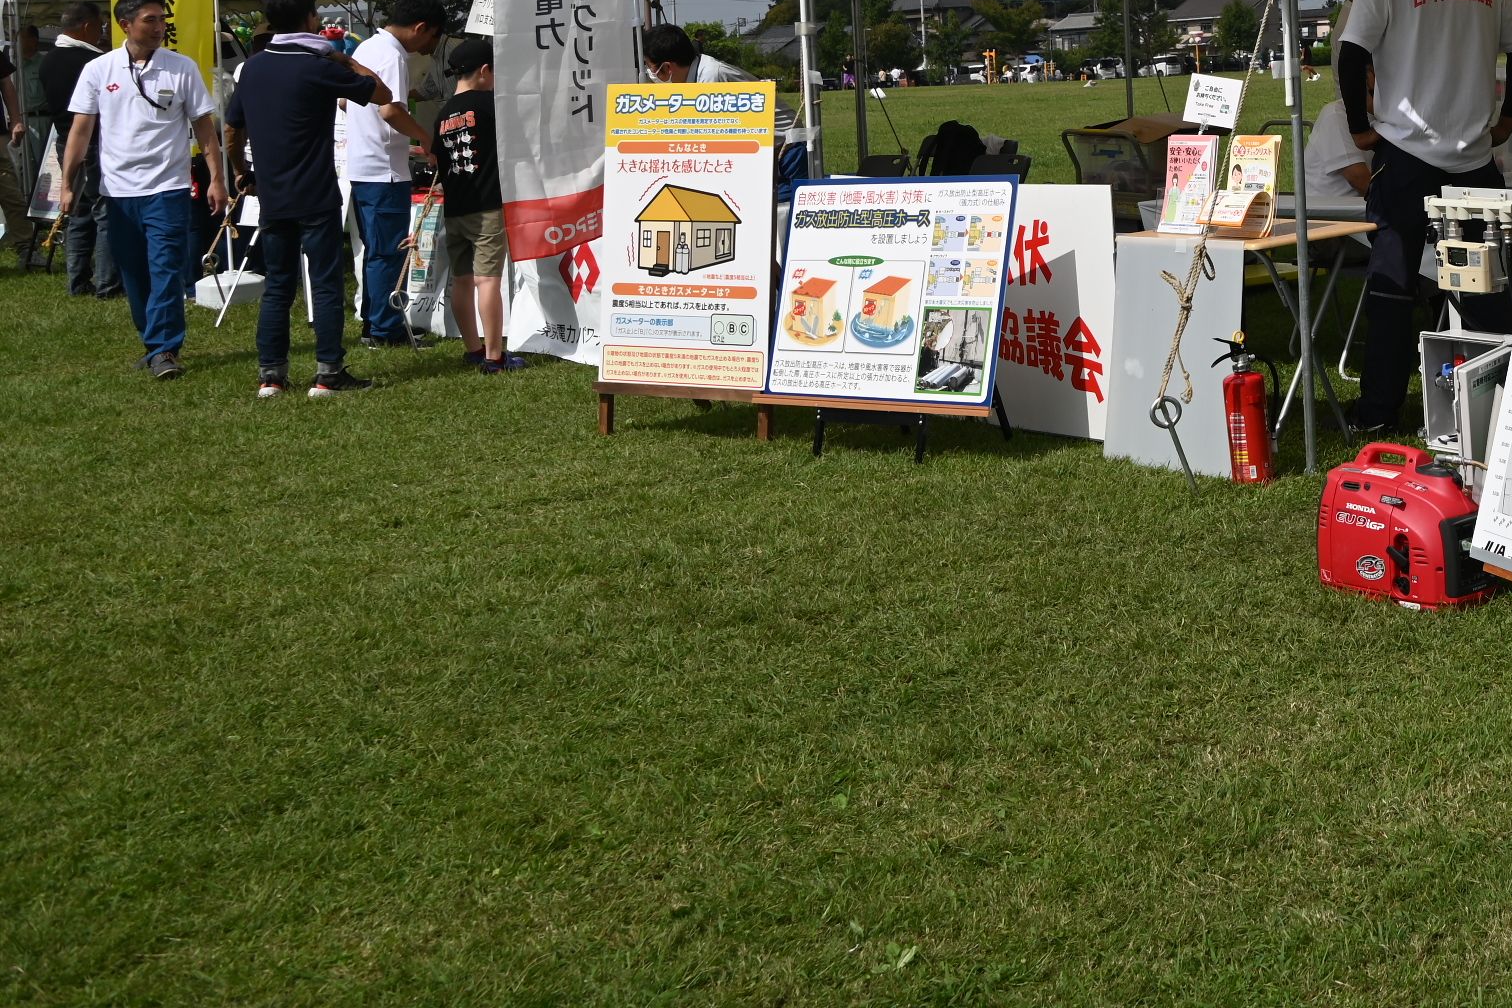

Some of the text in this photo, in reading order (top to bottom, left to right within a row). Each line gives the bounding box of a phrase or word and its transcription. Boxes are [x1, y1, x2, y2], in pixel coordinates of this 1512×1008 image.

[615, 92, 765, 114] ガスメーターのはたらき
[668, 143, 707, 153] こんなとき
[617, 159, 734, 174] 大きな揺れを感じたとき
[794, 209, 931, 229] ガス放出防止型高圧ホース
[871, 233, 928, 245] を設置しましょう
[1007, 219, 1052, 286] 伏
[615, 317, 674, 327] ガスメーターの表示部
[1346, 502, 1377, 515] HONDA
[1356, 559, 1386, 573] LPG
